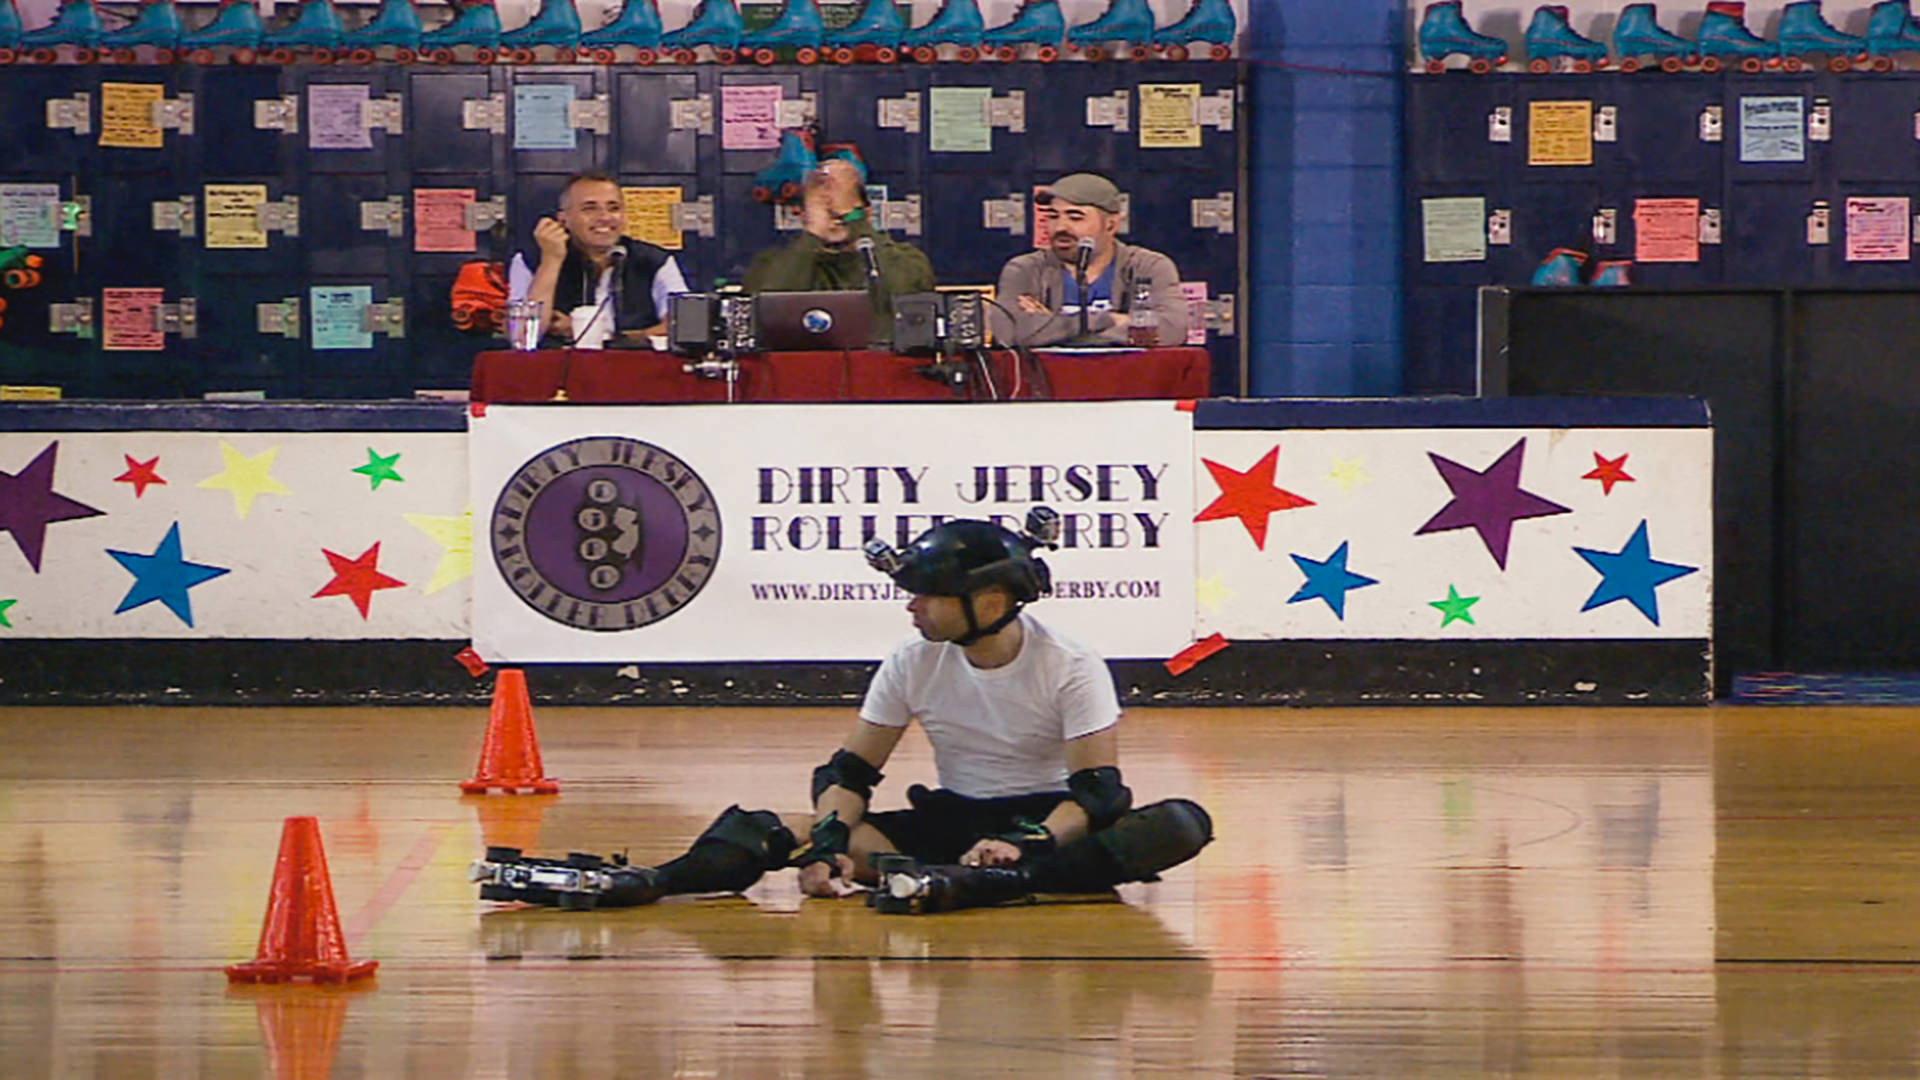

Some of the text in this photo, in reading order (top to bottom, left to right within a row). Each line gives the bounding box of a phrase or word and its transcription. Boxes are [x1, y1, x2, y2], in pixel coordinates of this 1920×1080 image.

[757, 464, 1170, 504] DIRTY JERSEY
[750, 513, 1170, 551] ROLLE RBY
